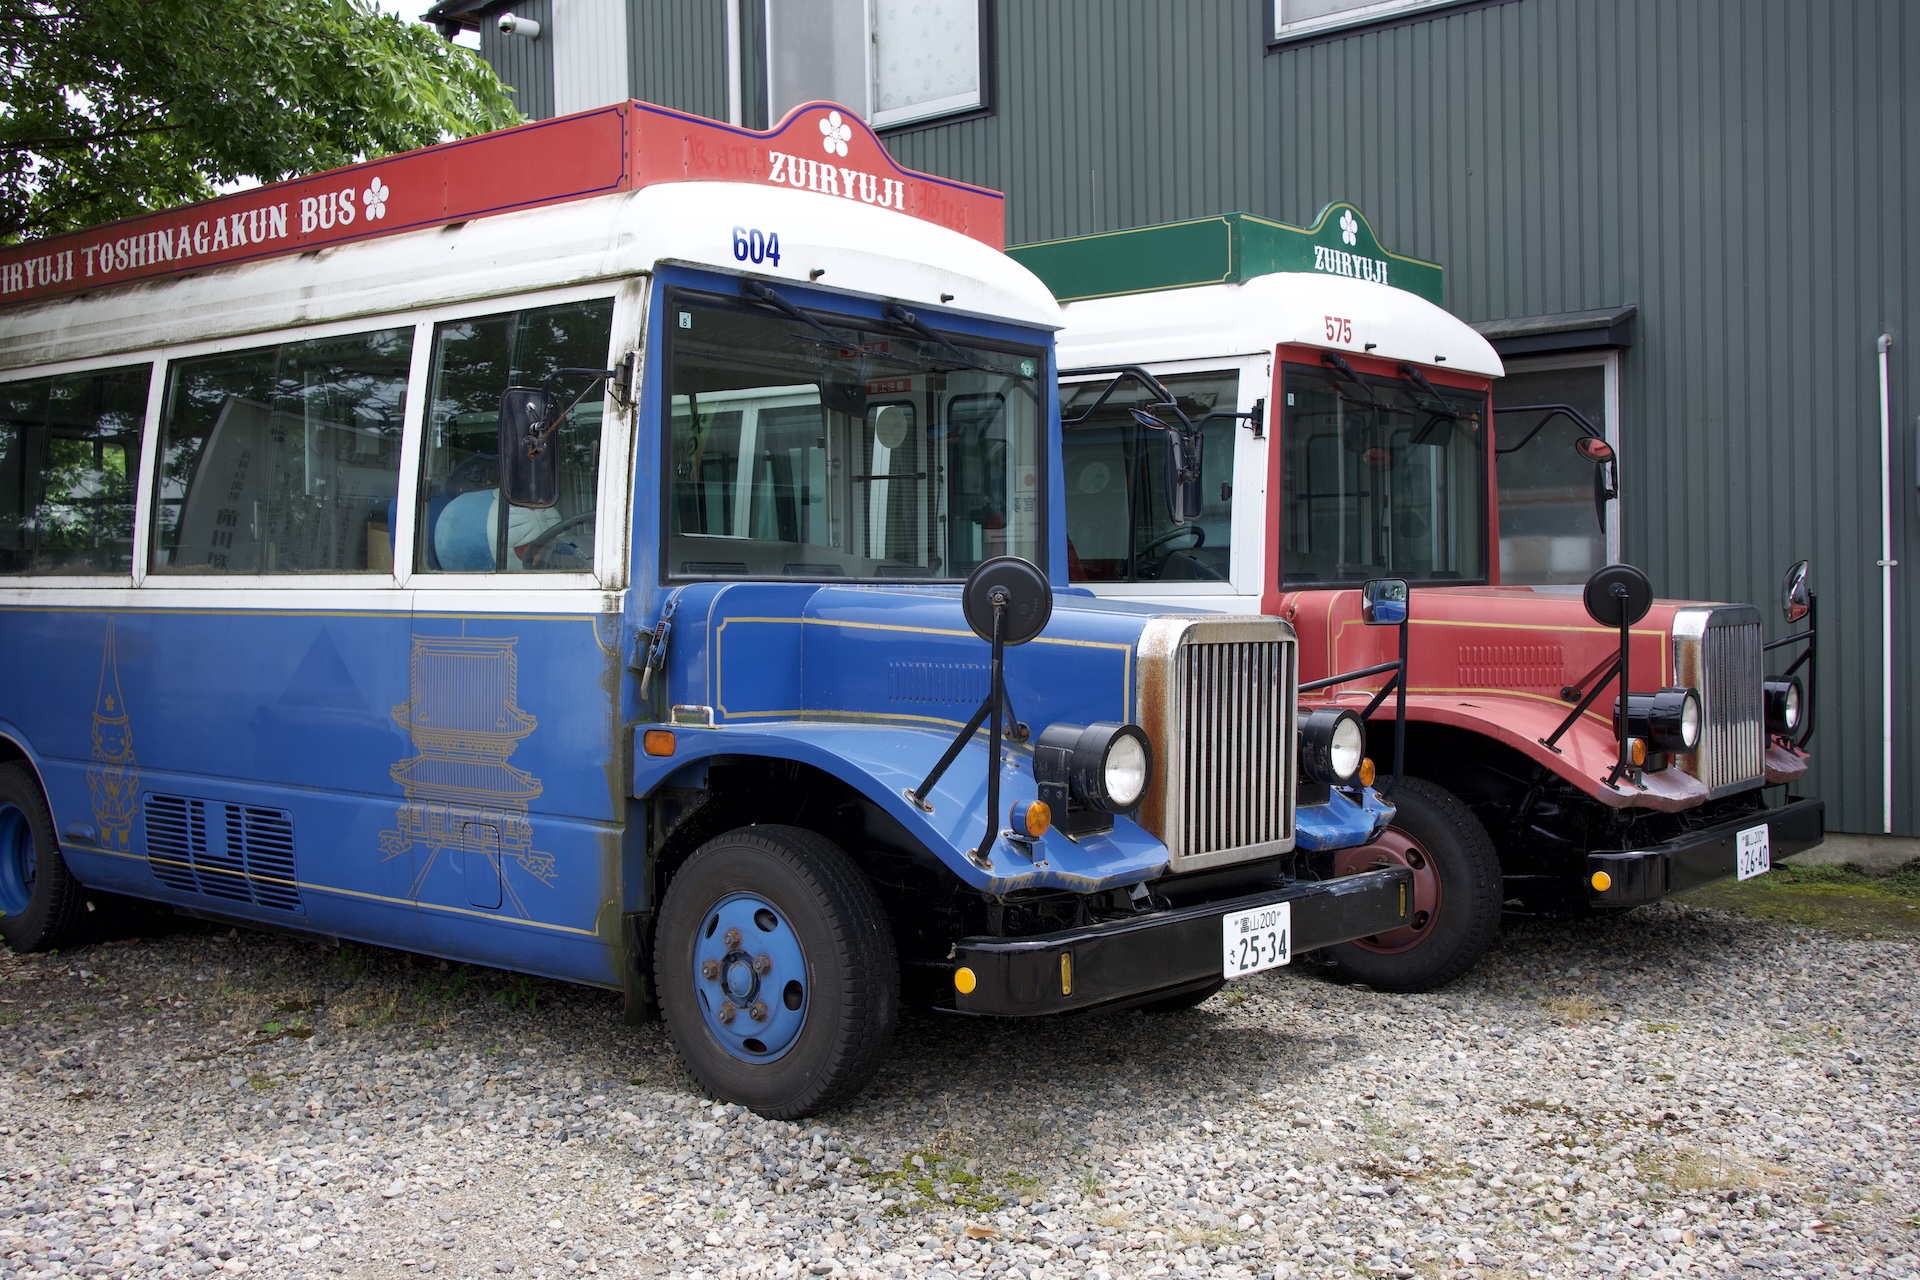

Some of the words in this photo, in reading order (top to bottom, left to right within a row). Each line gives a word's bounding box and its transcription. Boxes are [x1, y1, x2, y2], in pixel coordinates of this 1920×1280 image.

[768, 150, 905, 210] ZUIRYUJI
[0, 250, 73, 294] IRYUJI
[81, 203, 289, 277] TOSHINAGAKUN
[300, 188, 356, 234] BUS
[732, 225, 781, 268] 604
[1314, 245, 1389, 285] ZUIRYUJI
[1324, 315, 1352, 344] 575
[1229, 948, 1236, 966] さ
[1239, 929, 1287, 971] 25-34
